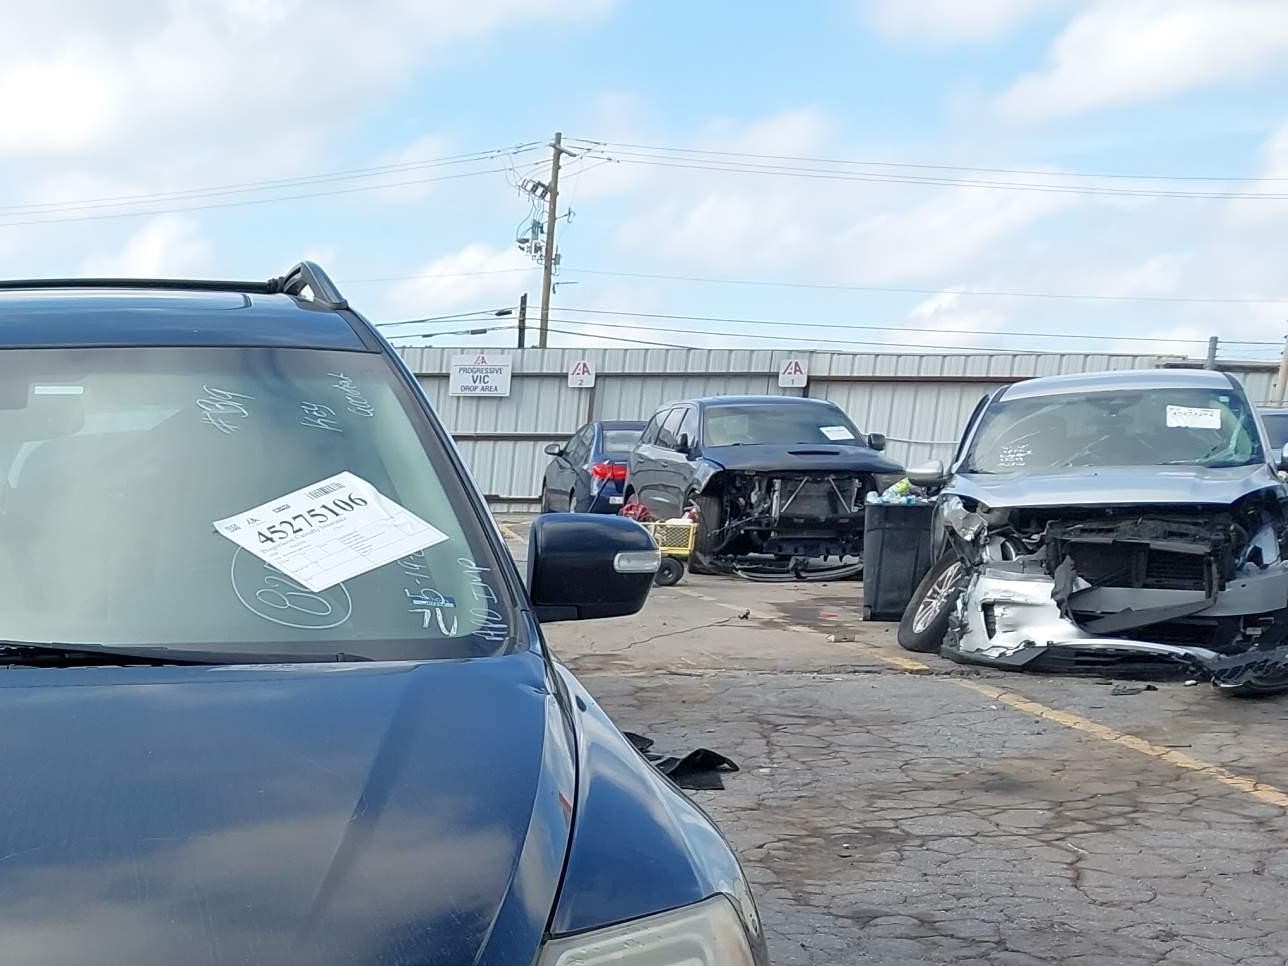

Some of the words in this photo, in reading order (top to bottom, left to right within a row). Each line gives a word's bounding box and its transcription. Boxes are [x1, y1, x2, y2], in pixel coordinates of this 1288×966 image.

[458, 367, 503, 375] PROGRESSIVE
[471, 374, 489, 385] VIC
[257, 491, 368, 544] 45275106
